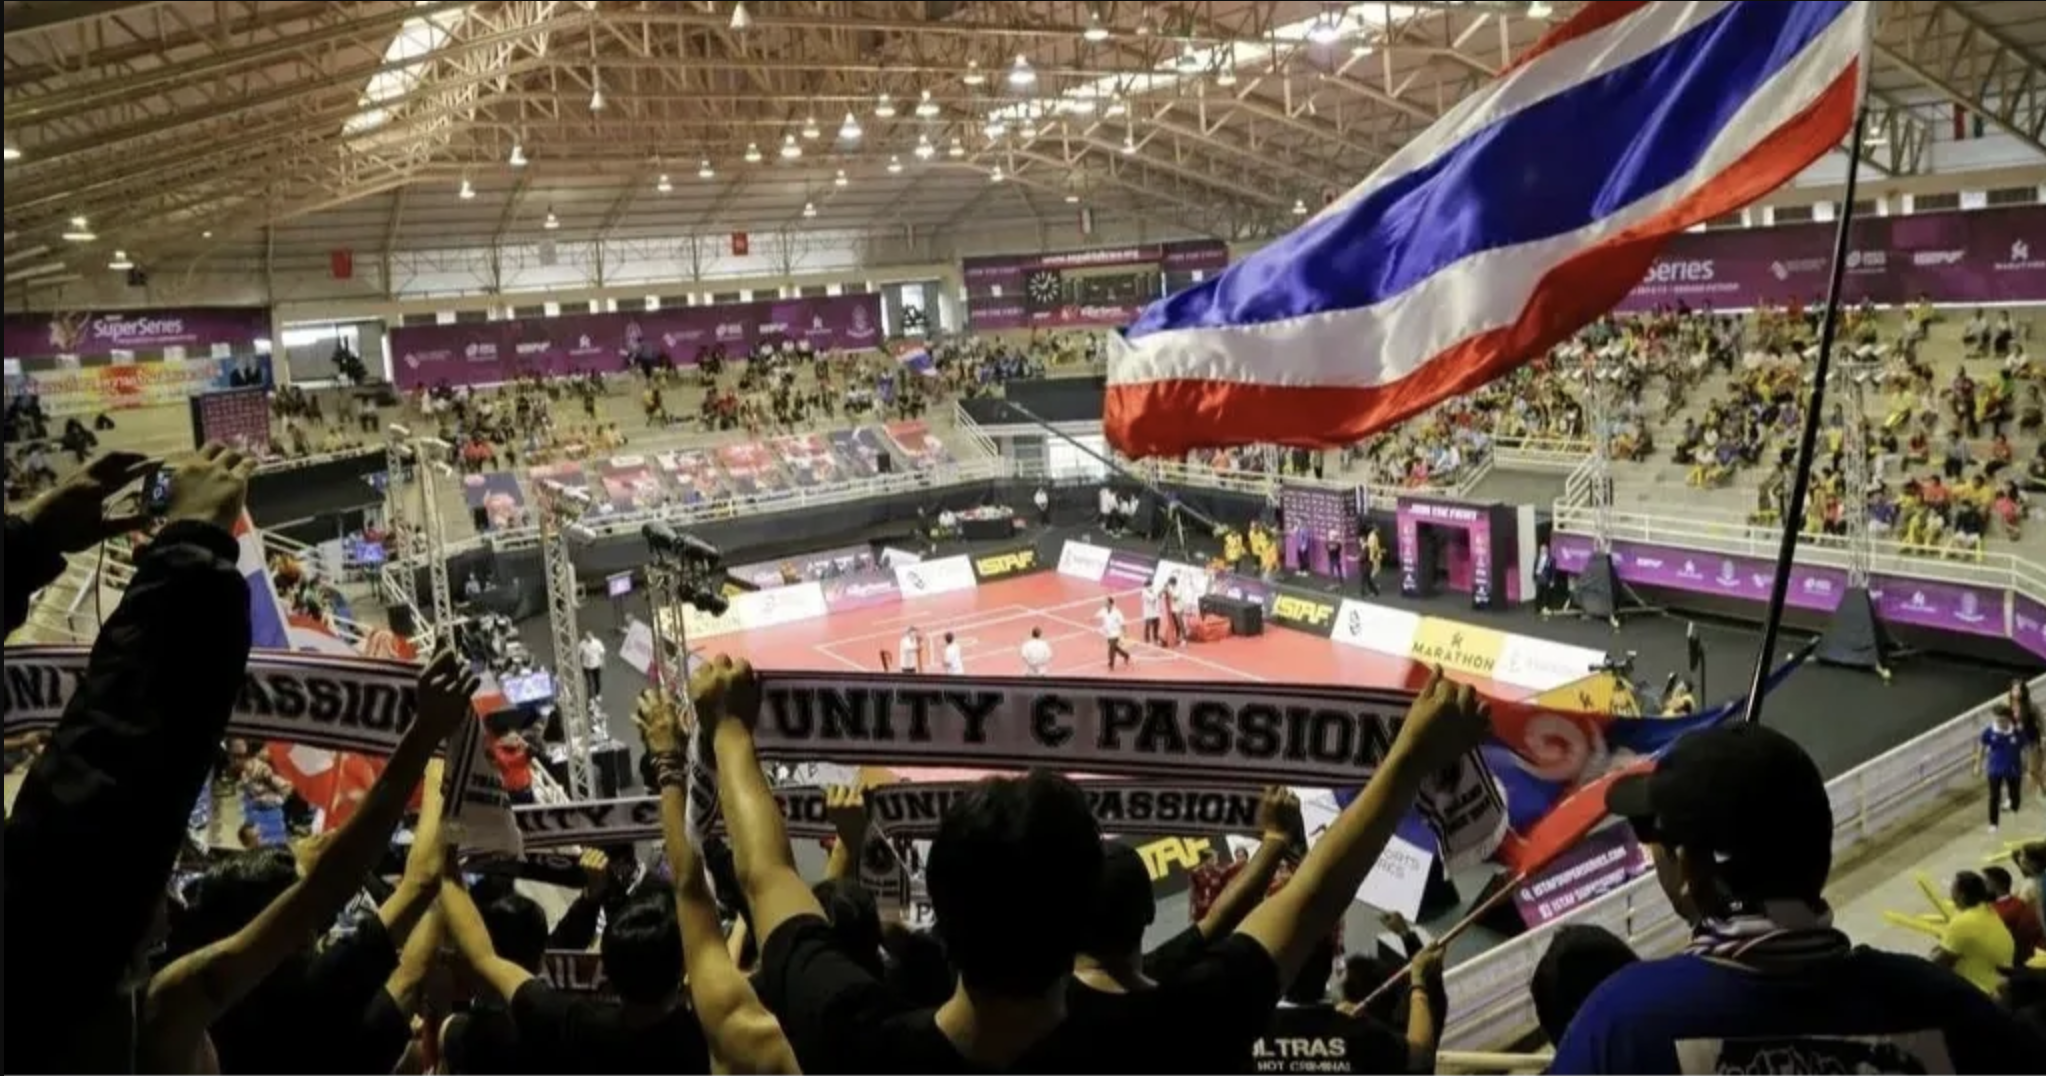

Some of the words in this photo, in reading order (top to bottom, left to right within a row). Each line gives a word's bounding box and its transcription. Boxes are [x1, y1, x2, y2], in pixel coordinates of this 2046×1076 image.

[1643, 256, 1714, 283] Series
[93, 317, 183, 342] SuperSeries
[976, 551, 1034, 577] ISTAF
[1273, 594, 1334, 625] ISTAF
[1411, 641, 1496, 672] MARATHON
[765, 688, 1004, 745] UNITY
[1096, 696, 1403, 768] PASSION
[1092, 790, 1258, 826] ASSION
[1135, 836, 1211, 882] TAF
[1252, 1037, 1346, 1058] LTRAS
